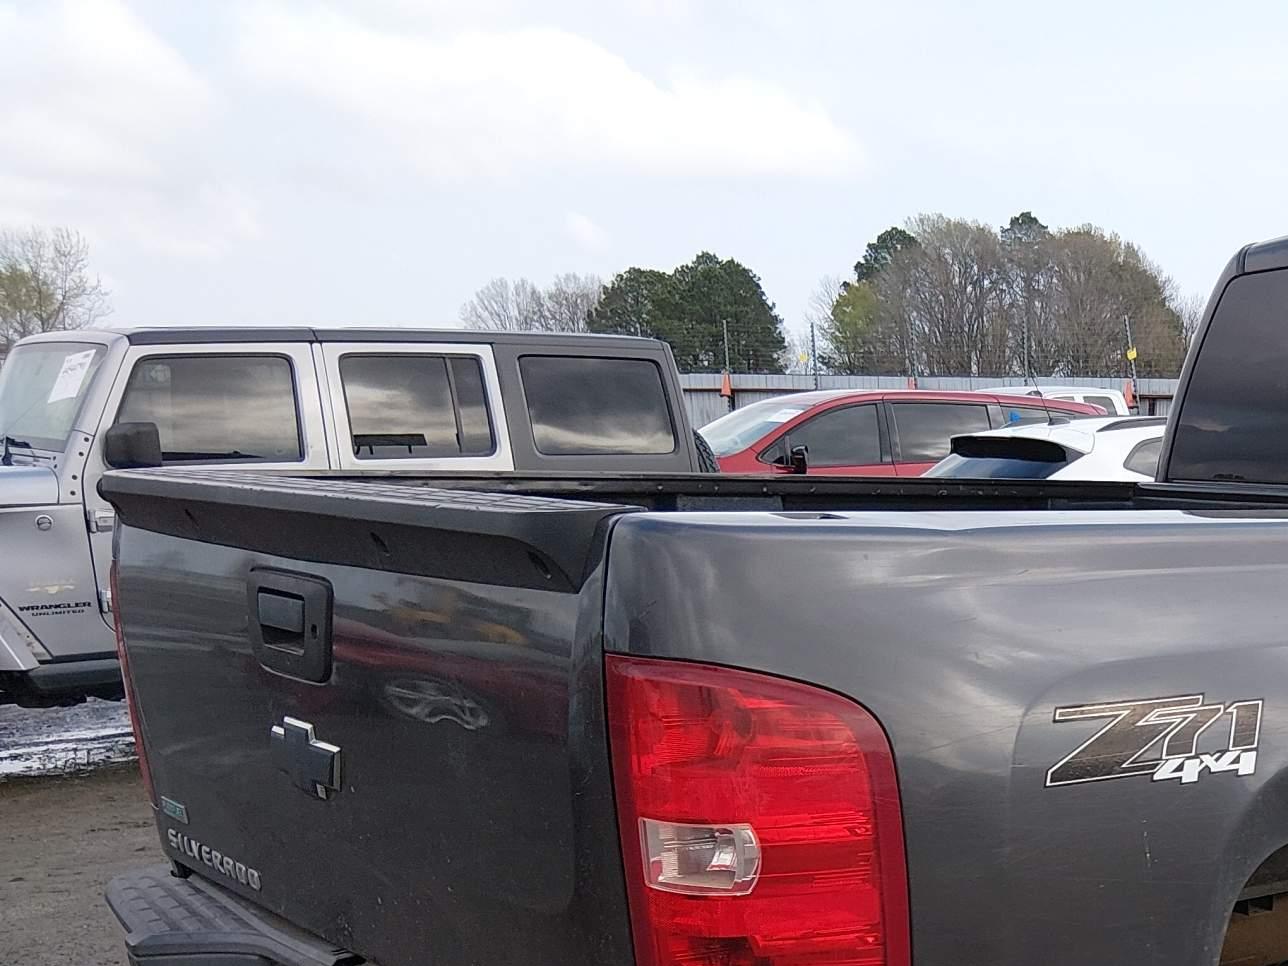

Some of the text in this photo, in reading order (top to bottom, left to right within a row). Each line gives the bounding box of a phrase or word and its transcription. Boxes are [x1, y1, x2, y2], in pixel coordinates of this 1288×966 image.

[18, 601, 92, 612] WRANGLER
[31, 609, 85, 617] UNLIMITED
[1045, 692, 1264, 788] Z71
[1152, 750, 1258, 785] 4x4
[167, 828, 261, 891] SILVERADO
